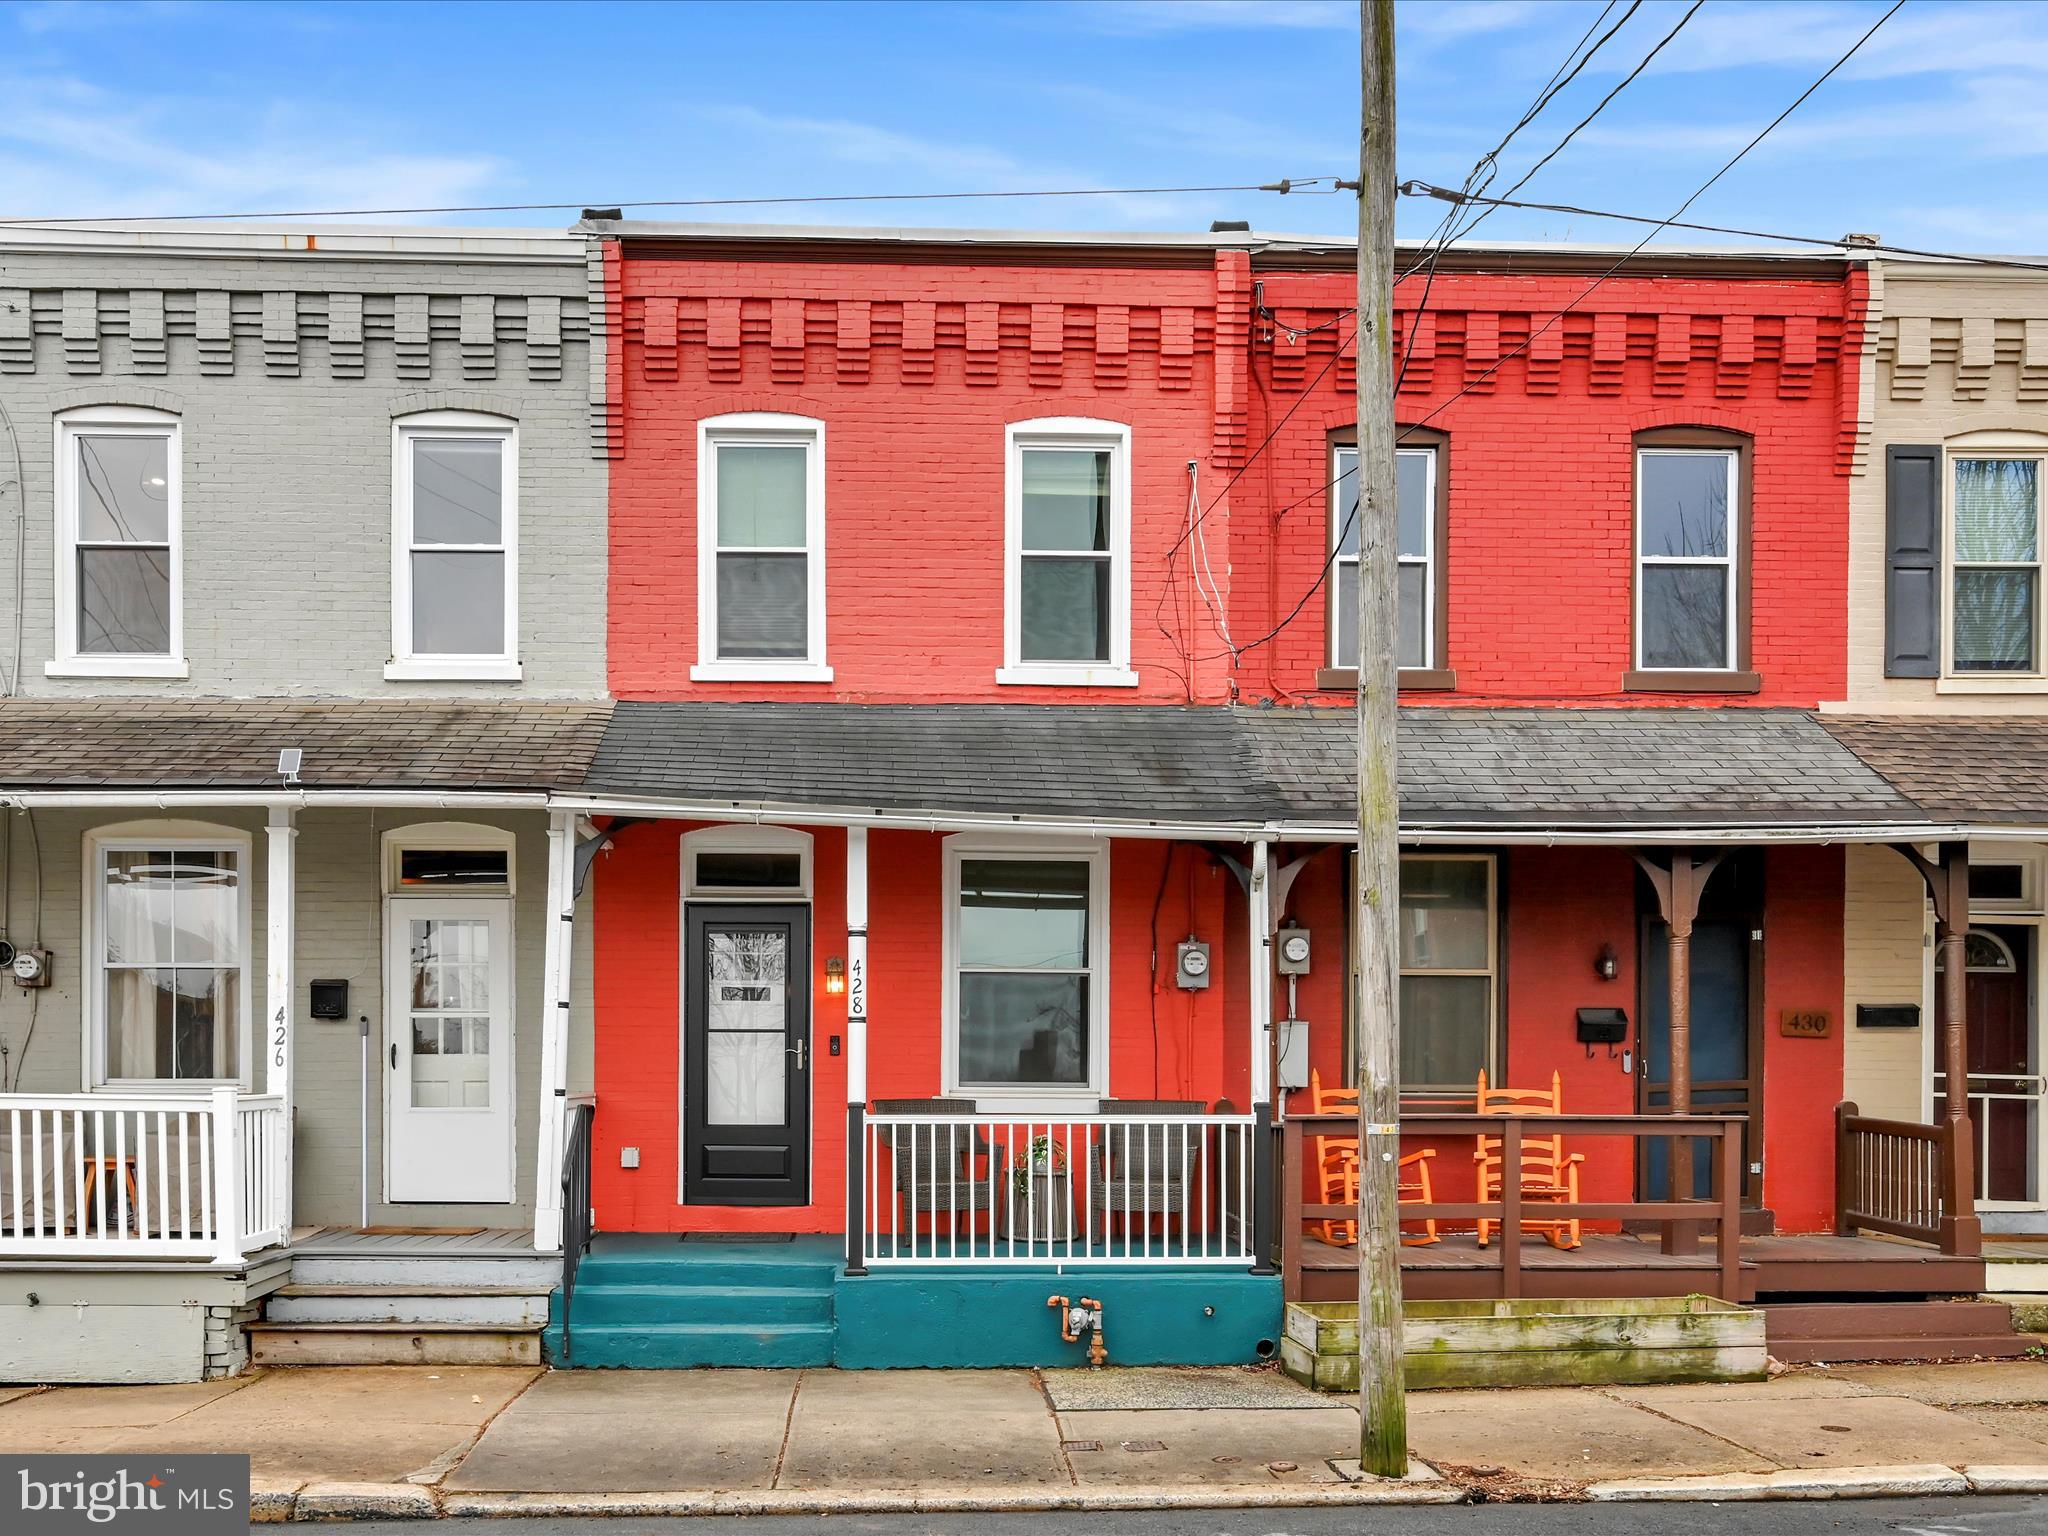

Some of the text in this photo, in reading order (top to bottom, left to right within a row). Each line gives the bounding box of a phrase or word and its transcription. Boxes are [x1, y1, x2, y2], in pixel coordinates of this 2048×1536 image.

[852, 959, 863, 1014] 428
[274, 1005, 286, 1067] 426
[1788, 1014, 1826, 1032] 430
